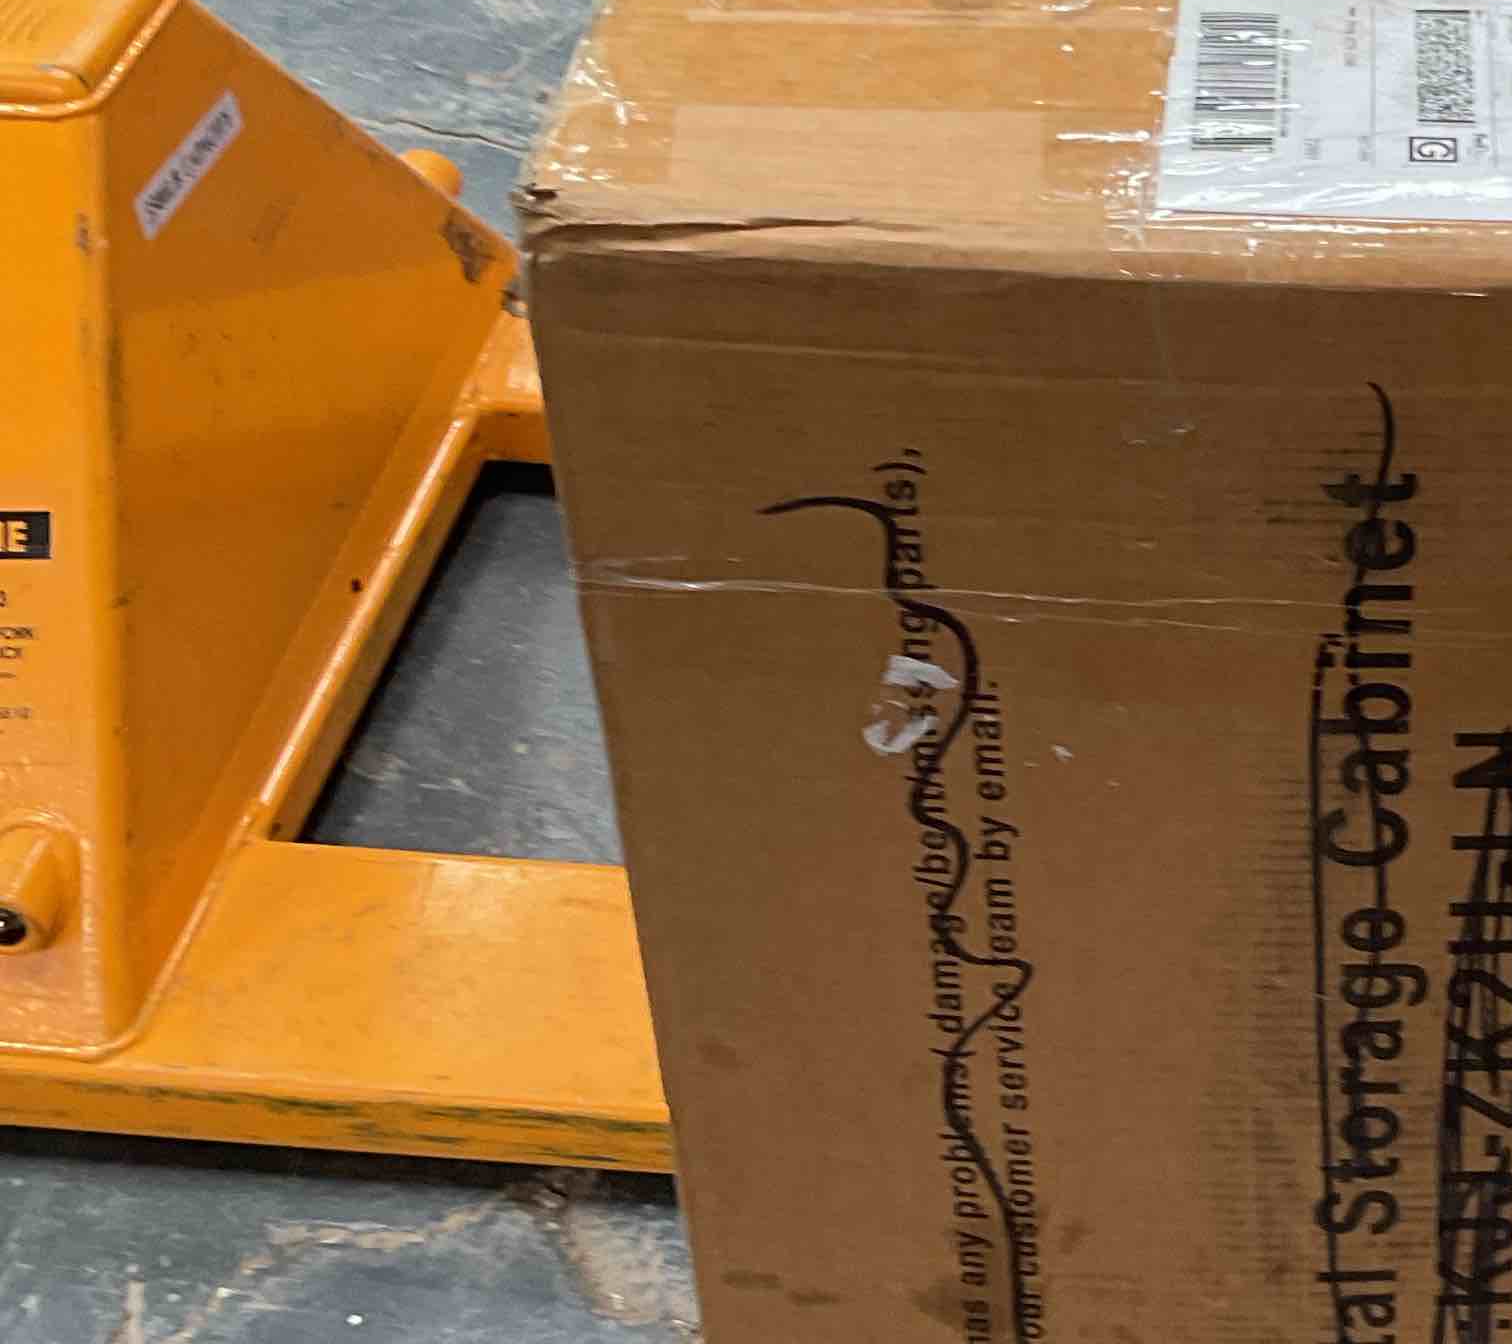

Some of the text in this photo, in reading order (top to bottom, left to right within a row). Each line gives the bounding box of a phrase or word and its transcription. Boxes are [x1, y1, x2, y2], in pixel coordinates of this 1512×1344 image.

[1314, 474, 1417, 866] Cabinet
[974, 817, 1018, 860] by
[980, 879, 1018, 960] team
[985, 982, 1026, 1110] service
[1315, 908, 1428, 1234] Storage
[999, 1124, 1039, 1276] customer
[956, 1232, 992, 1286] any
[1016, 1289, 1042, 1340] our
